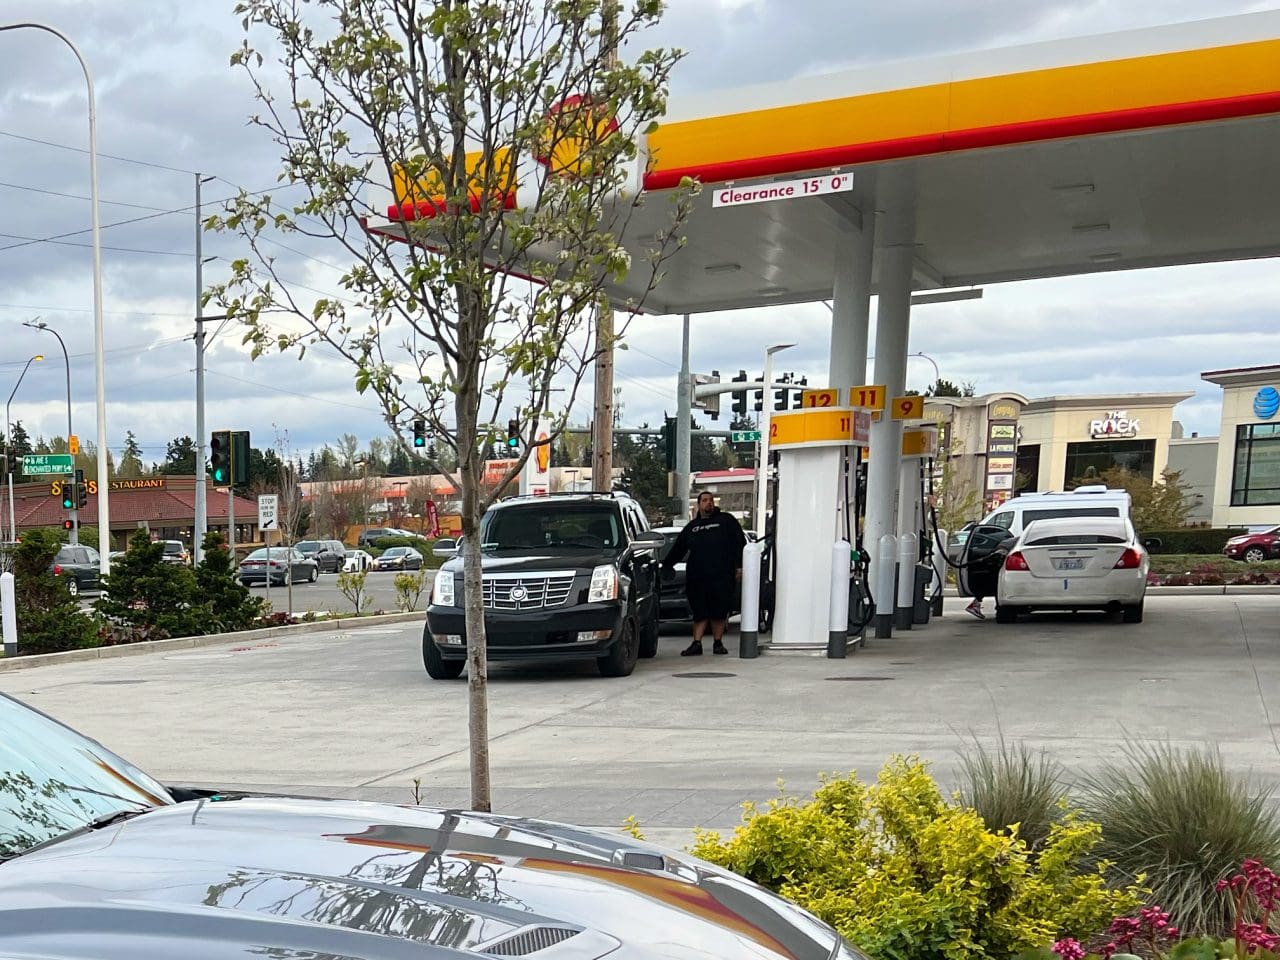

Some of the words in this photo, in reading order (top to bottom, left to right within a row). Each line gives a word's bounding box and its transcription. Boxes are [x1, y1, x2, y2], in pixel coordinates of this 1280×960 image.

[720, 185, 794, 204] Clearance
[803, 179, 823, 194] 15'
[831, 176, 848, 190] 0"
[809, 393, 831, 407] 12
[858, 389, 876, 406] 11
[900, 401, 913, 415] 9
[1107, 410, 1128, 420] THE
[770, 423, 778, 437] 2
[840, 417, 850, 432] 11
[1090, 418, 1141, 434] ROCK
[111, 479, 164, 489] STAURANT
